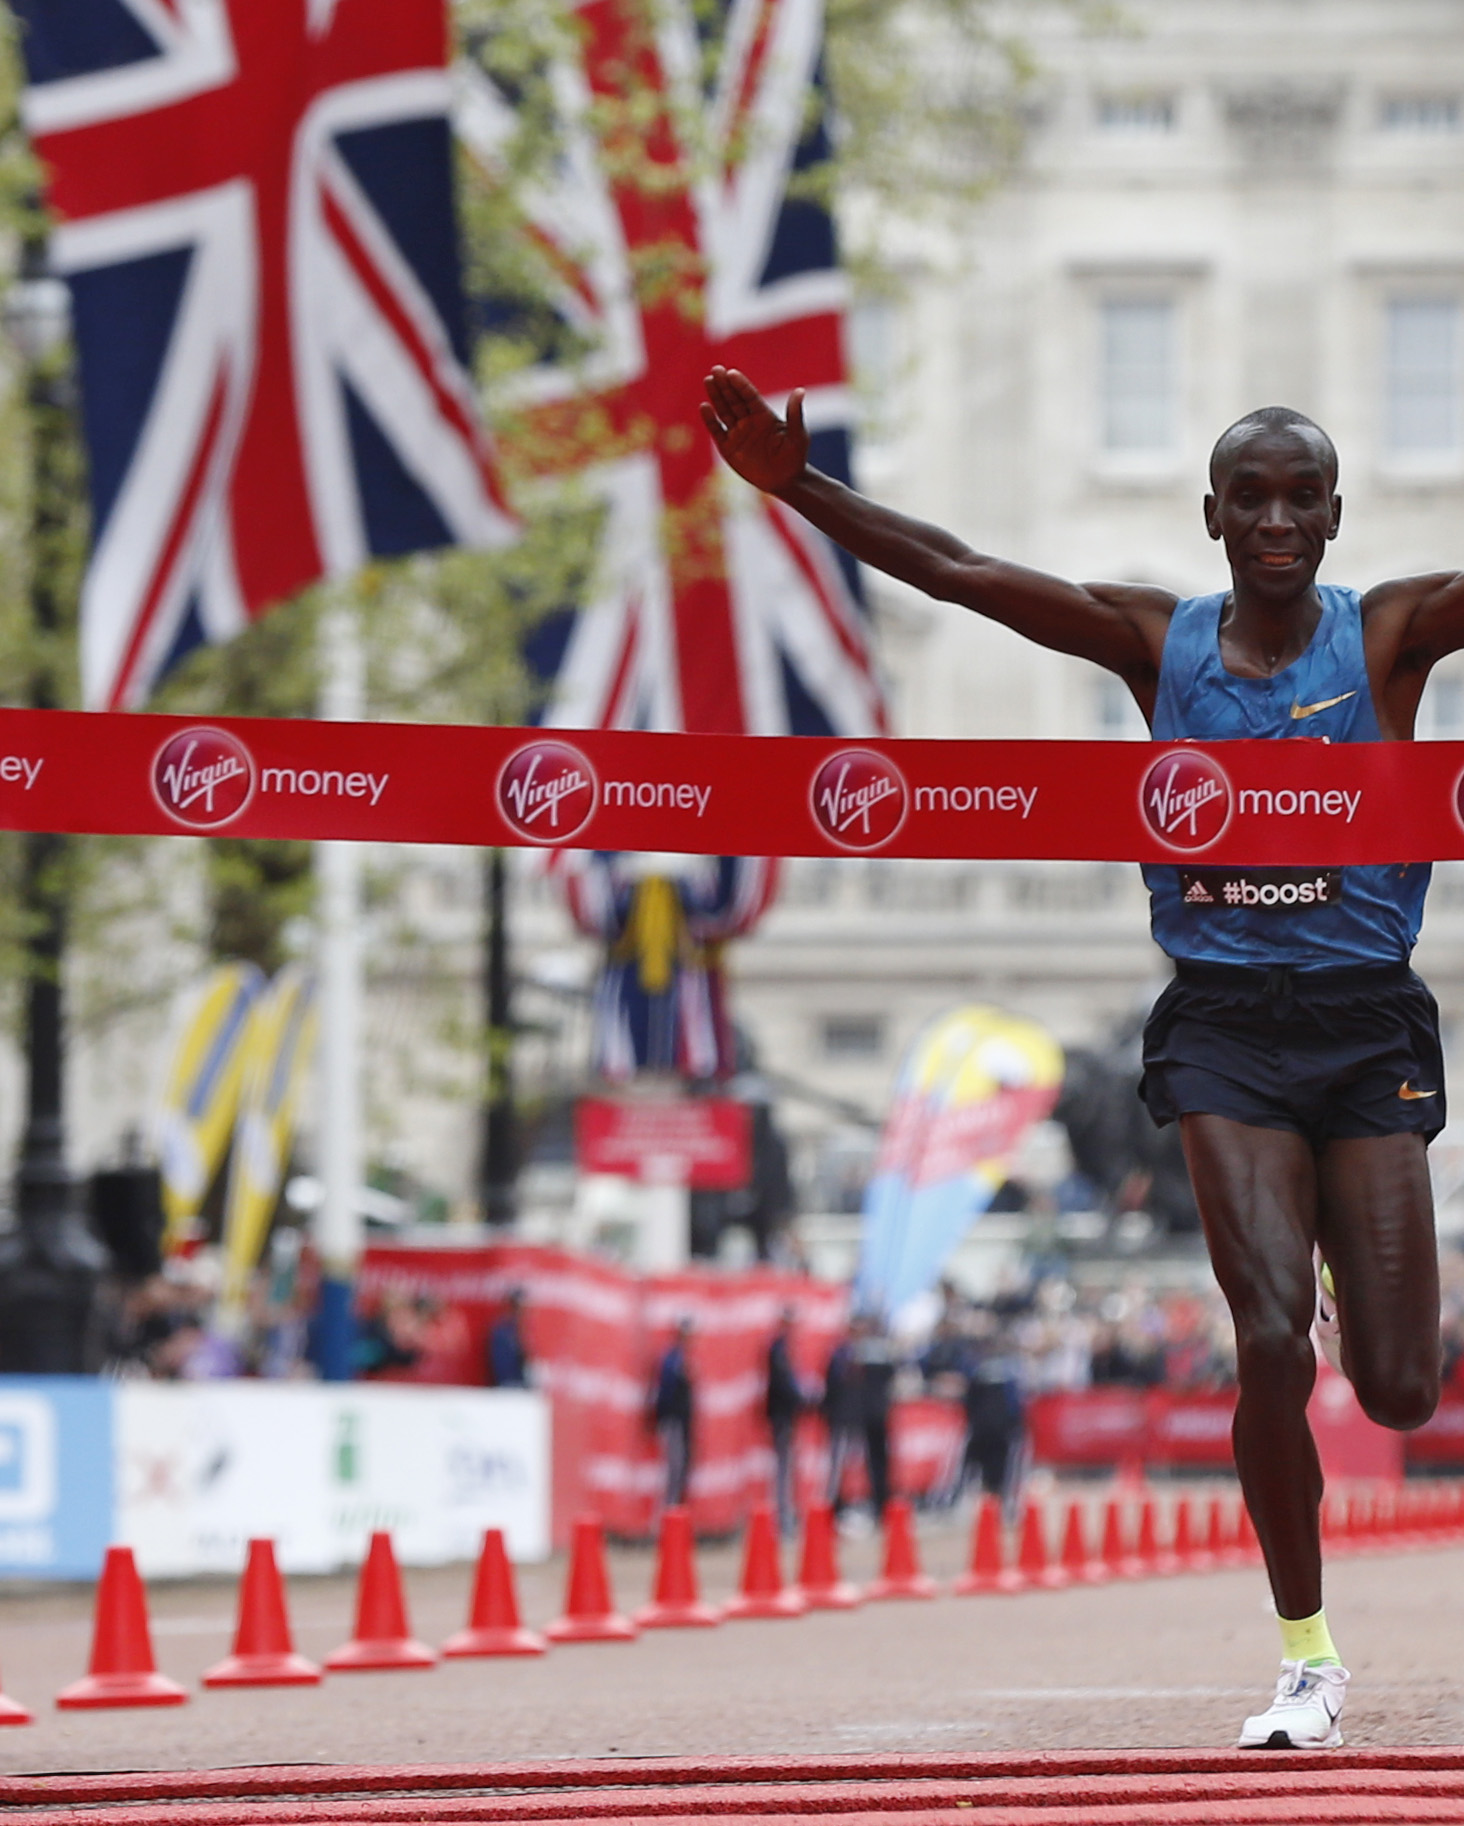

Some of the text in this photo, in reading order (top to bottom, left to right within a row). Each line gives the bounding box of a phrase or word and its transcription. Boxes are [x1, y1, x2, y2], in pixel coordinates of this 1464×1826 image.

[164, 741, 389, 812] Virgin money
[508, 755, 712, 826] Virgin money
[821, 762, 1038, 834] Virgin money
[1150, 763, 1362, 836] Virgin money
[1222, 876, 1329, 906] #boost
